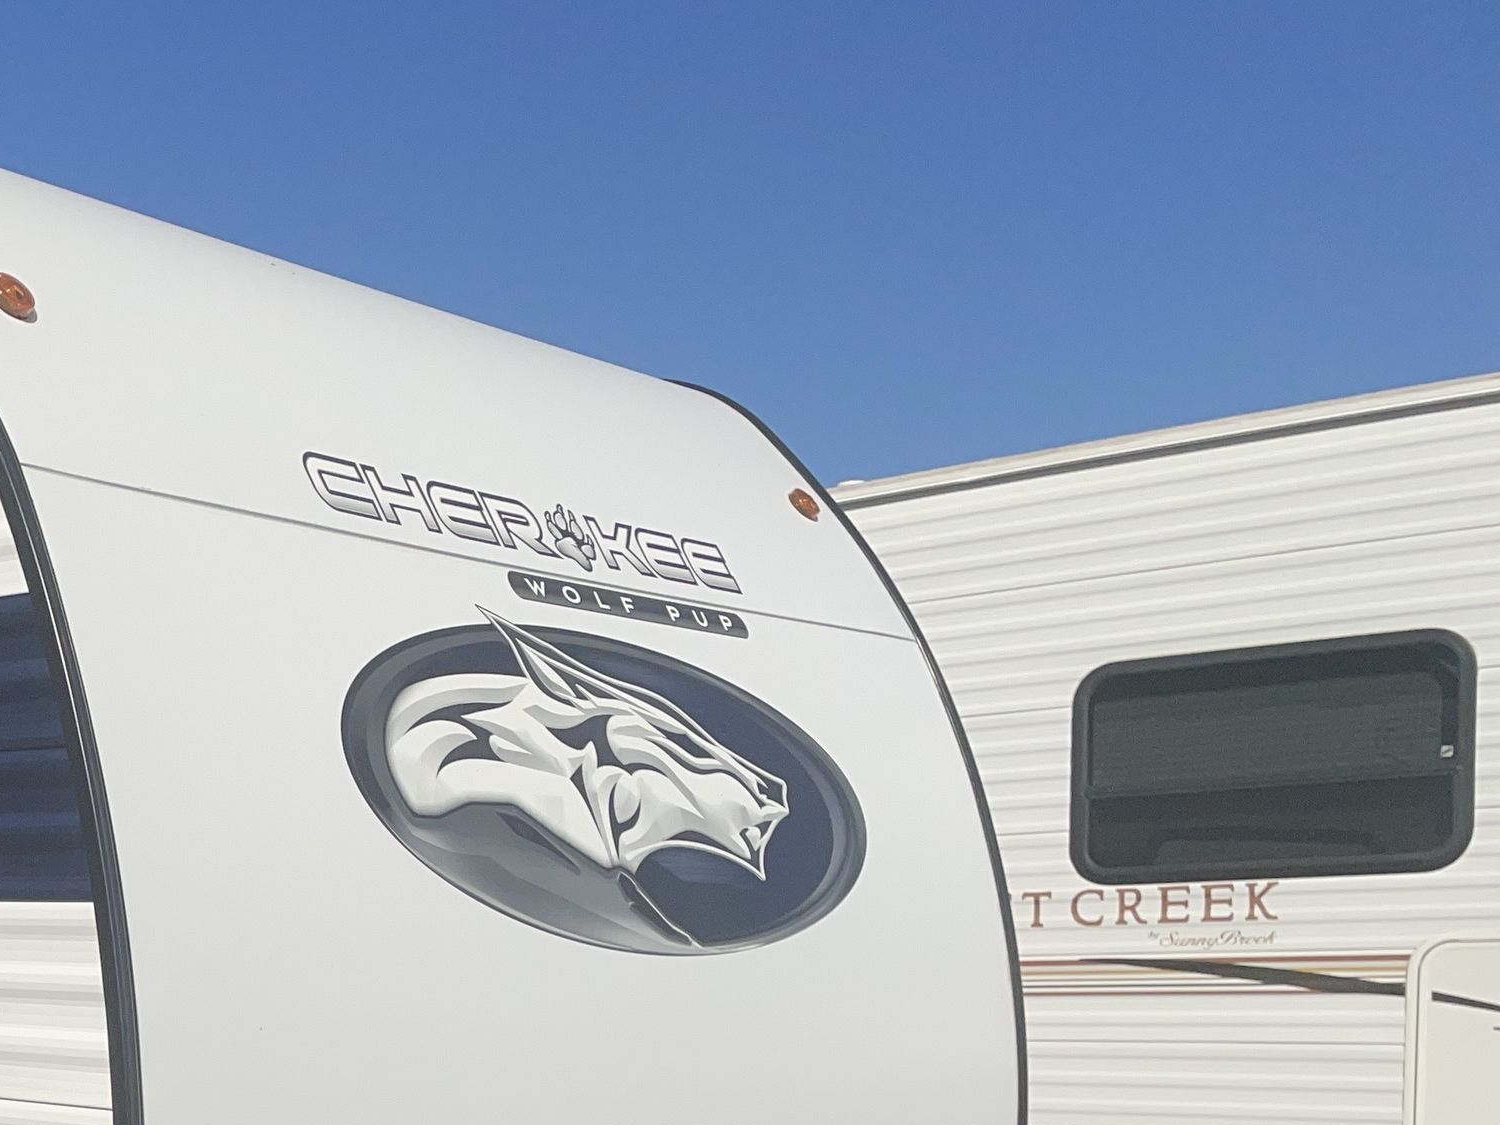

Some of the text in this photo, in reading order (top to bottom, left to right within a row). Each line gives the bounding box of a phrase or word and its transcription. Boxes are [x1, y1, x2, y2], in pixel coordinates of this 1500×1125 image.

[523, 577, 734, 632] WOLF PUP
[1008, 881, 1280, 928] T CREEK
